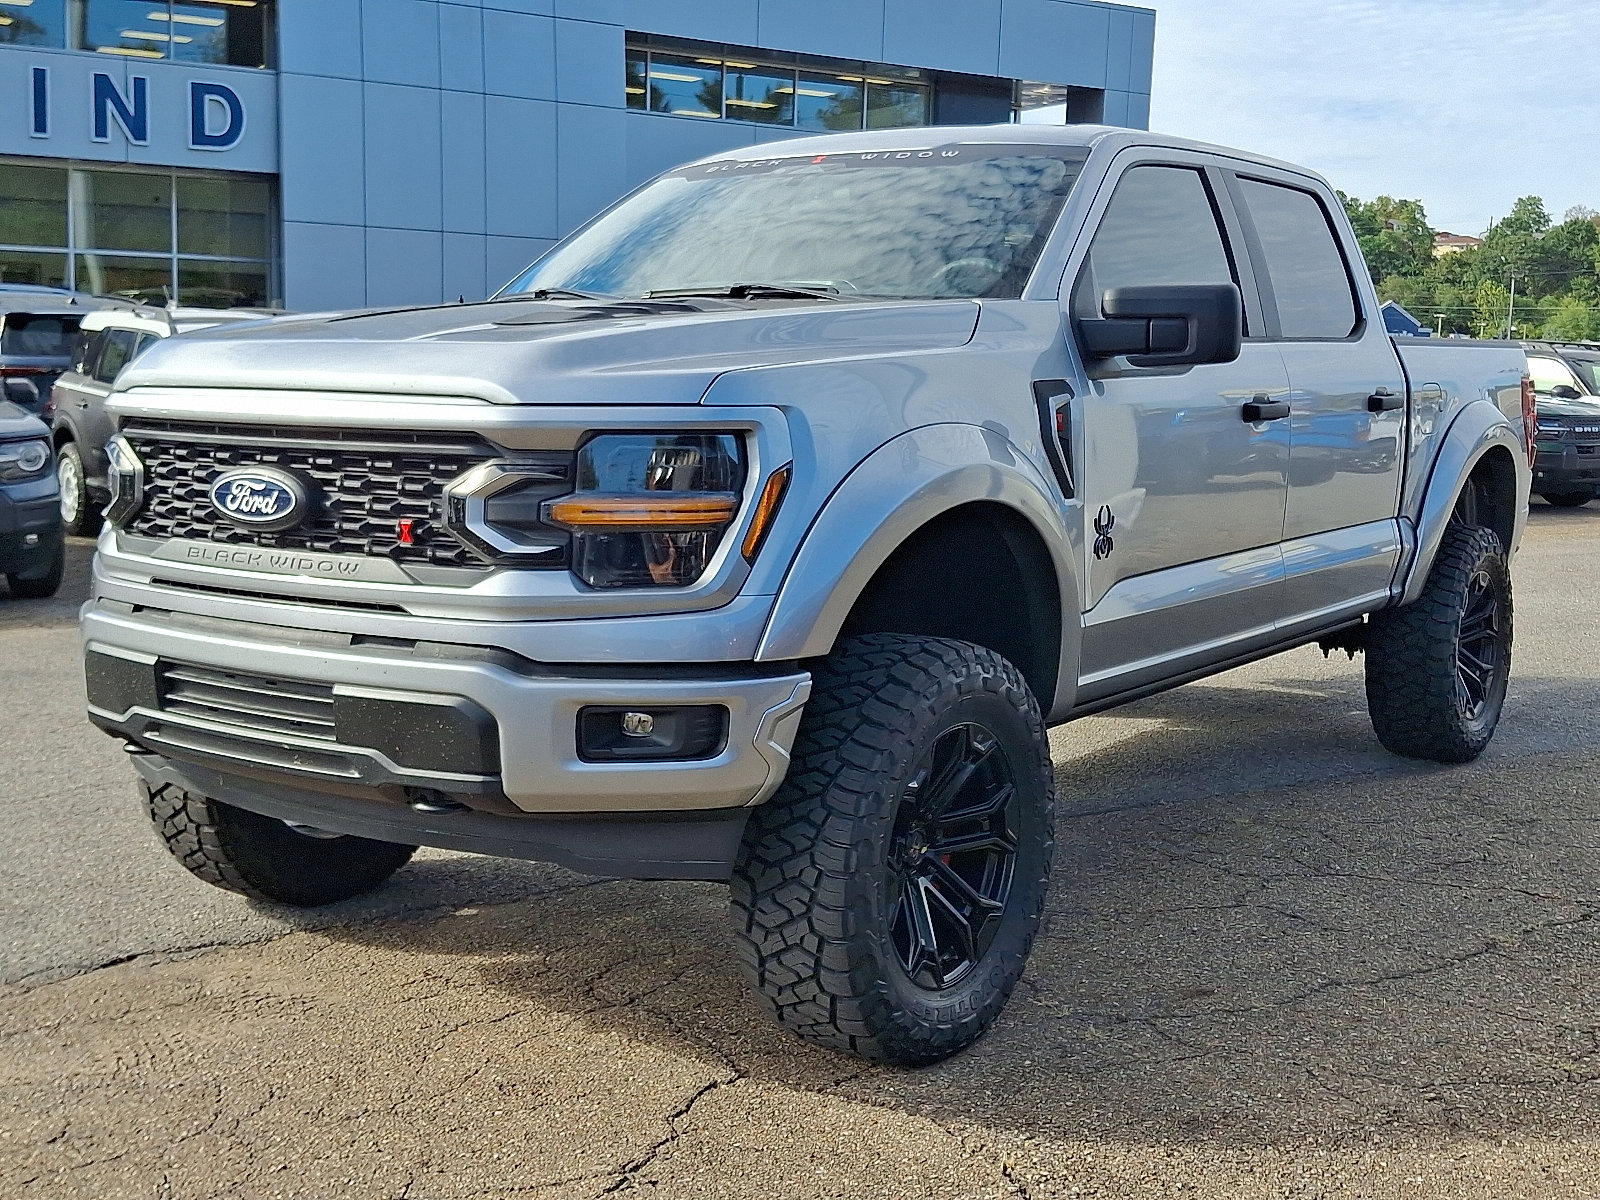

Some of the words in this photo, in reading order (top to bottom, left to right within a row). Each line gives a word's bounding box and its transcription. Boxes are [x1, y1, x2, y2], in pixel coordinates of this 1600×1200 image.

[31, 66, 247, 151] IND
[705, 159, 783, 173] BLACK
[860, 149, 960, 161] WIDOW
[227, 480, 280, 514] Ford
[187, 546, 263, 567] BLACK
[269, 555, 361, 576] WIDOW
